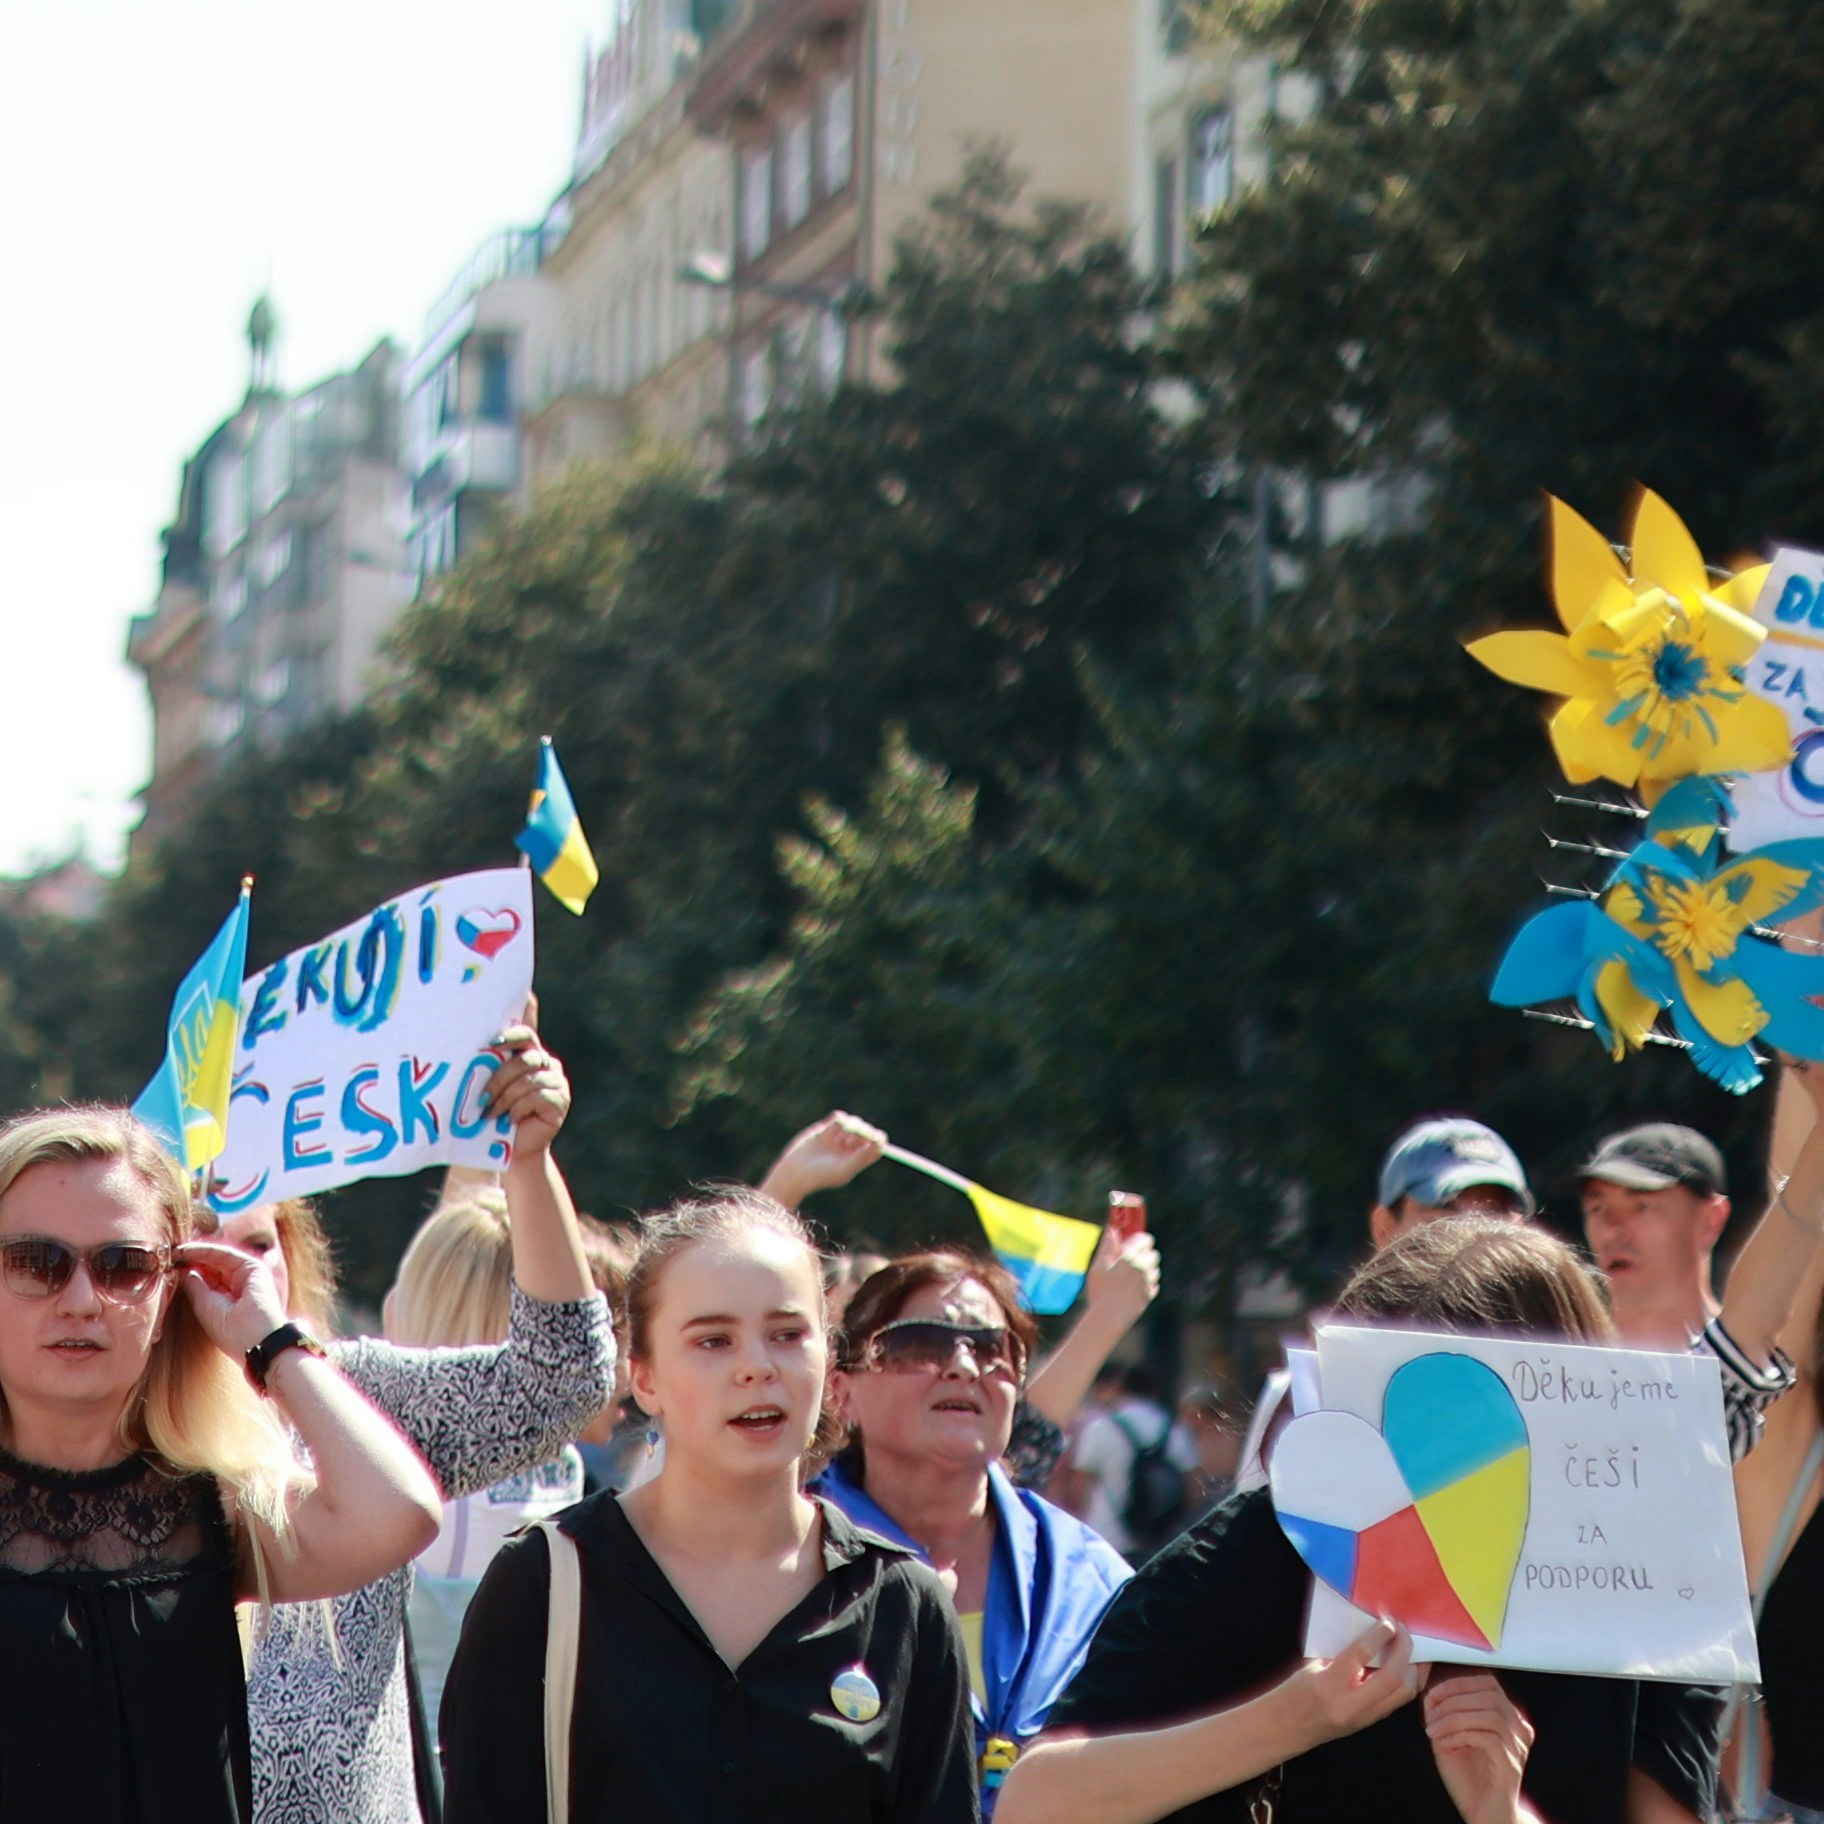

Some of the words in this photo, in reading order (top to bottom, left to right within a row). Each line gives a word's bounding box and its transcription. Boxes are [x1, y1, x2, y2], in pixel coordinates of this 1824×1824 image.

[1512, 1357, 1679, 1411] Děkujeme
[1577, 1525, 1609, 1545] ZA
[1525, 1563, 1655, 1592] PODPORU
